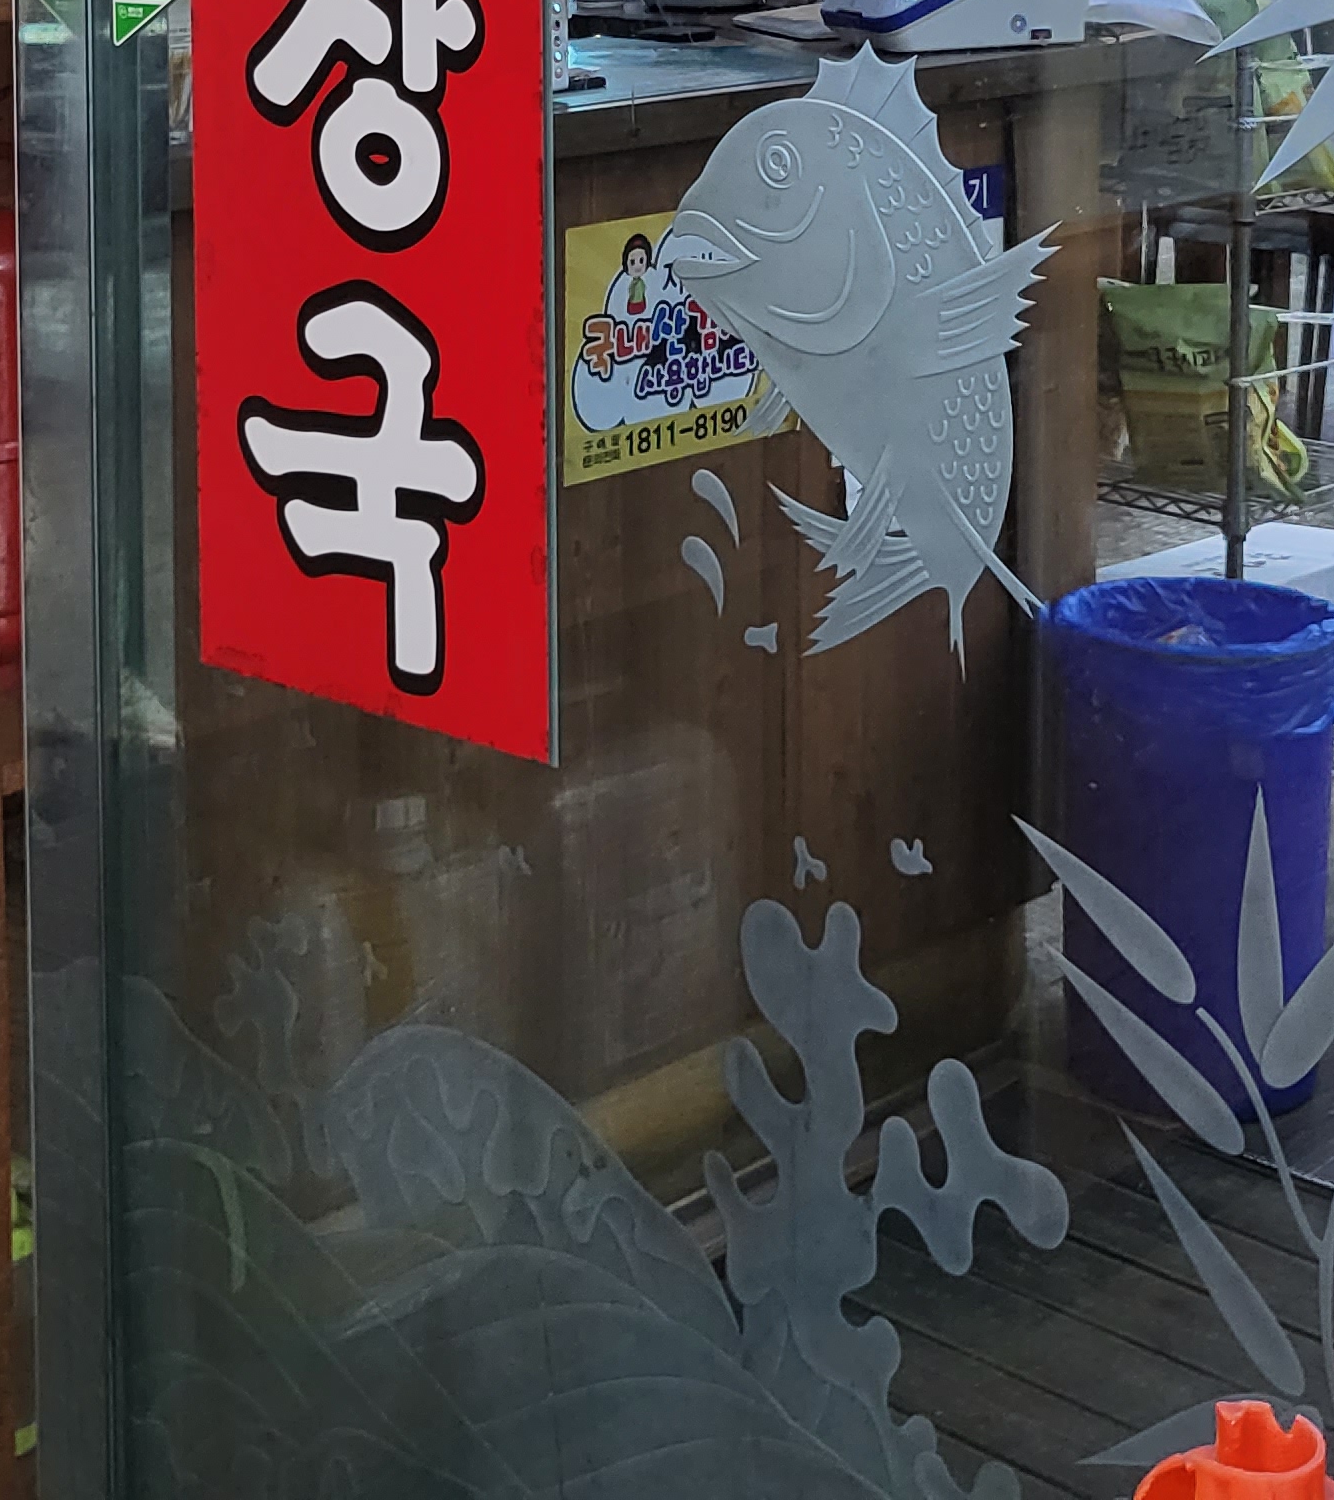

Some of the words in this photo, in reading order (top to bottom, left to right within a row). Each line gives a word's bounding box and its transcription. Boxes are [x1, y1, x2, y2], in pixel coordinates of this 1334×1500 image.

[583, 300, 689, 382] 국내산
[634, 346, 759, 404] 사용합니다
[625, 403, 748, 457] 1811-8190
